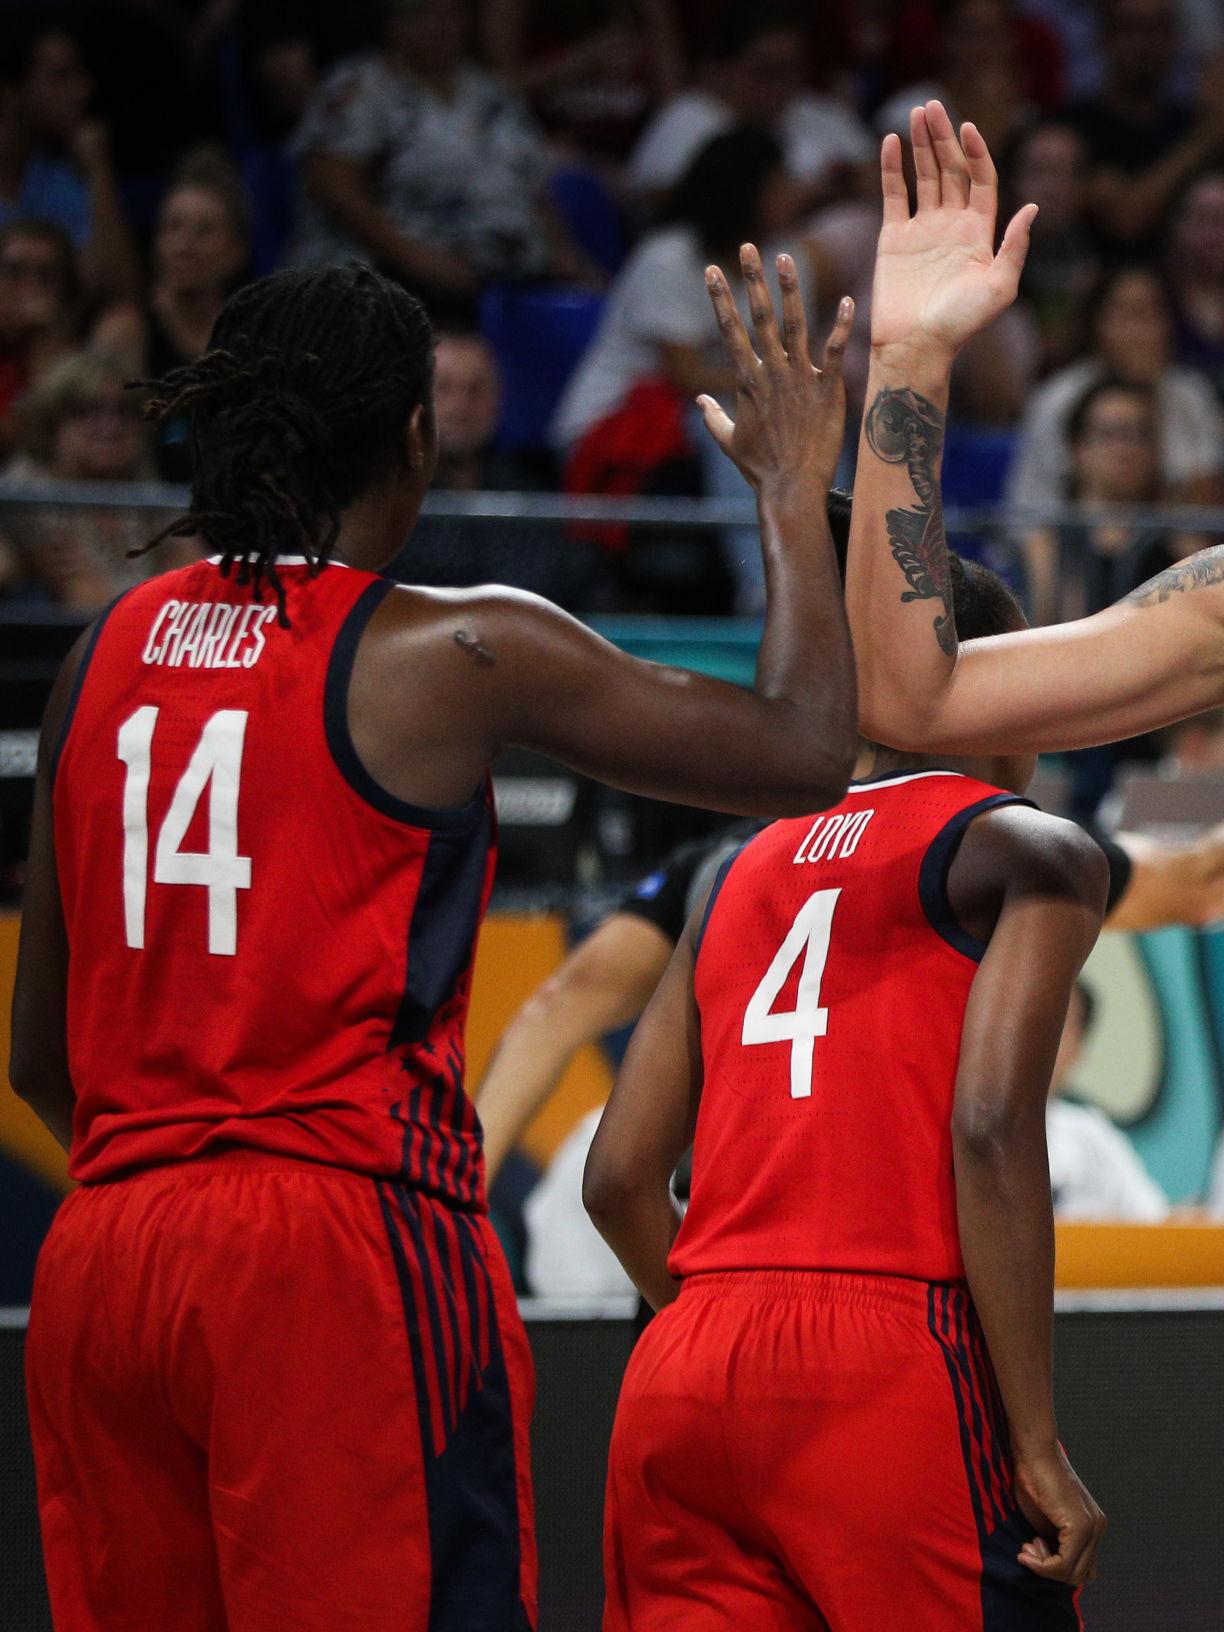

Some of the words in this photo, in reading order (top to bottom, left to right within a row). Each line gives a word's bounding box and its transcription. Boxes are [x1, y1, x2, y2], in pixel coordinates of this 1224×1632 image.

[142, 599, 278, 668] CHARLES
[117, 706, 252, 956] 14
[792, 808, 875, 864] LOYD
[741, 887, 843, 1099] 4
